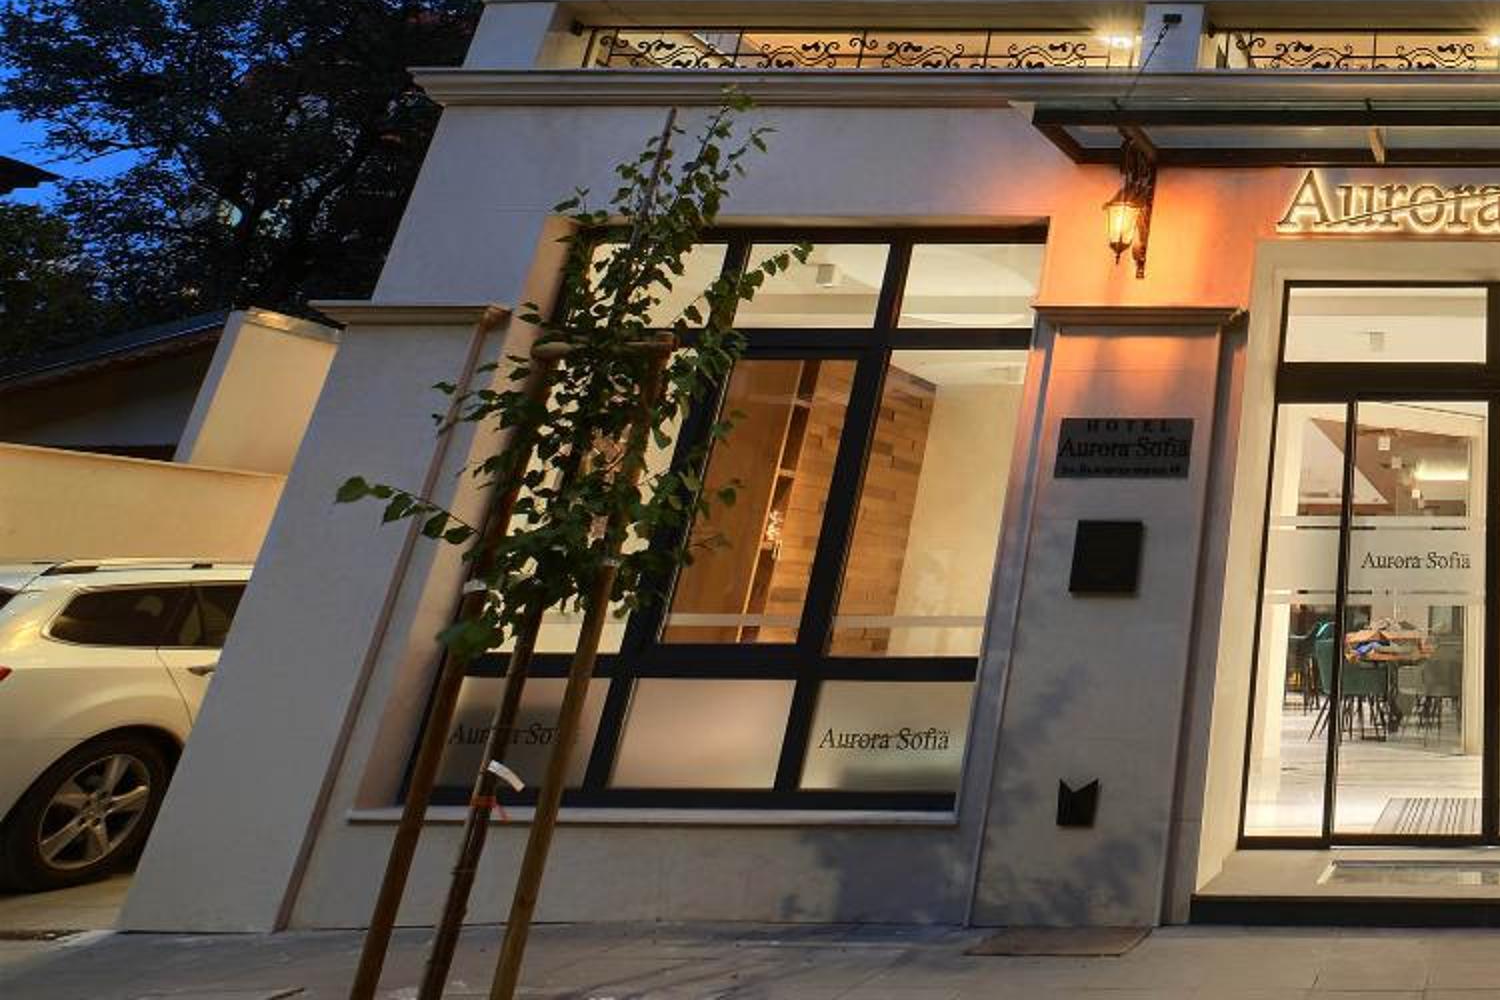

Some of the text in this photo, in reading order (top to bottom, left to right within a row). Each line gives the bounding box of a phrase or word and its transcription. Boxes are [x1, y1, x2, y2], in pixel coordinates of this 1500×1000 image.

[1087, 420, 1171, 433] HOTEL
[1058, 436, 1188, 456] Aurora Sofia
[1361, 551, 1471, 569] Aurora Sofia
[818, 727, 949, 750] Aurora Sofia
